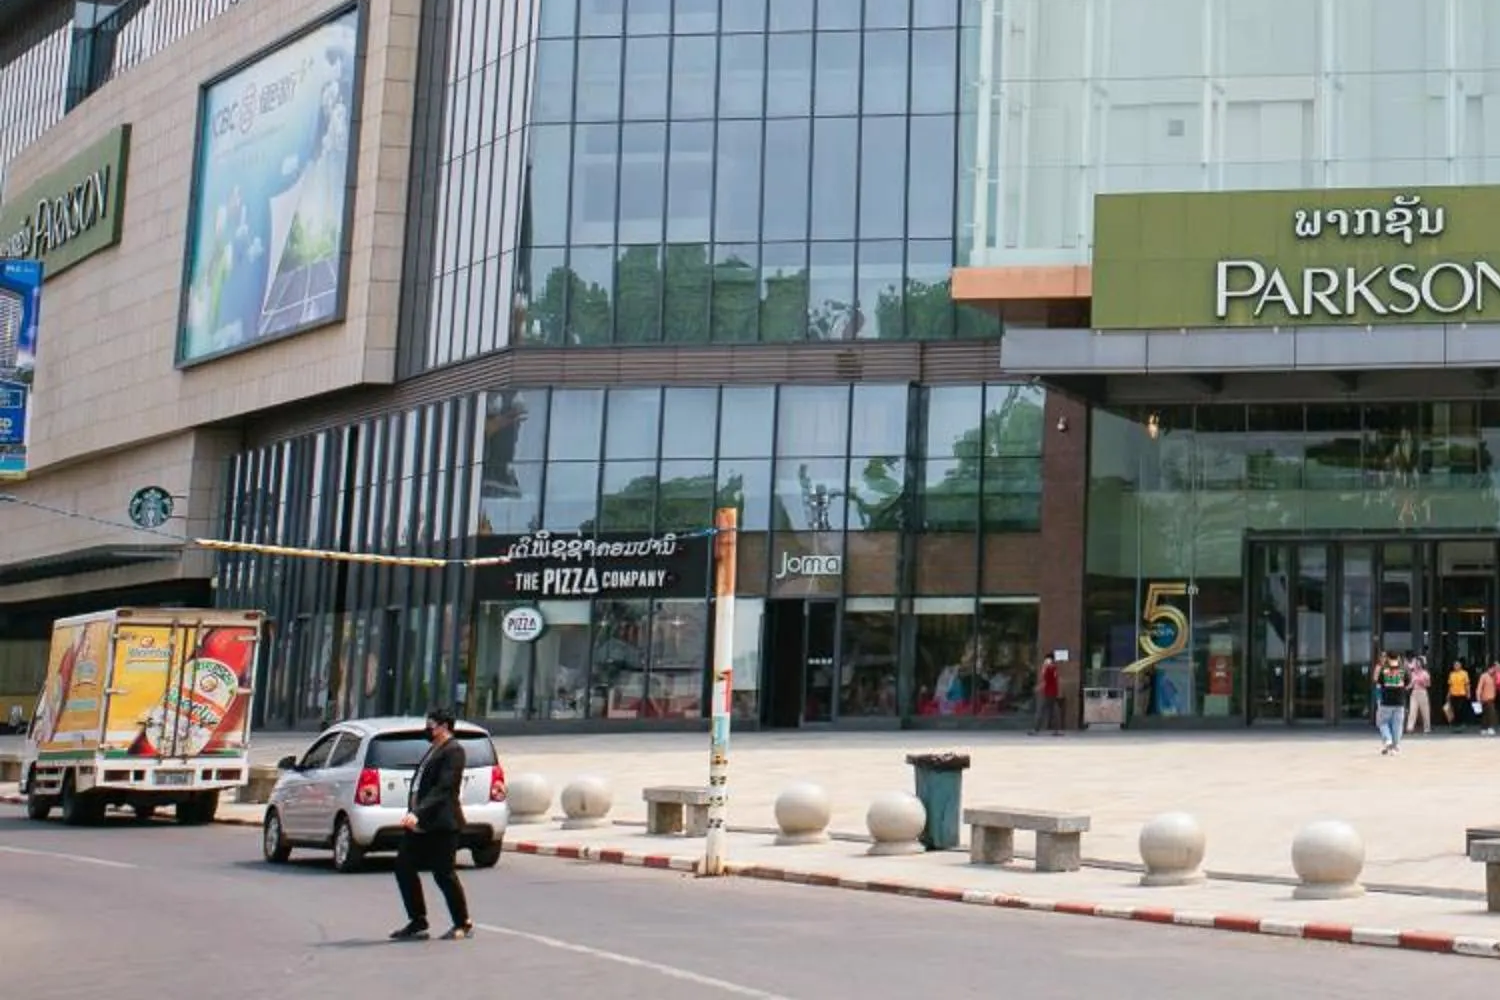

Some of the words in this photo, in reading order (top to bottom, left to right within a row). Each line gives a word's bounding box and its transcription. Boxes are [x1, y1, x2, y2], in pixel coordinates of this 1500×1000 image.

[1294, 195, 1445, 245] ພາກຊັນ
[775, 552, 842, 579] Joma
[515, 572, 540, 591] THE
[542, 567, 600, 595] PIZZA
[602, 570, 668, 589] COMPANY
[508, 617, 537, 632] PIZZA
